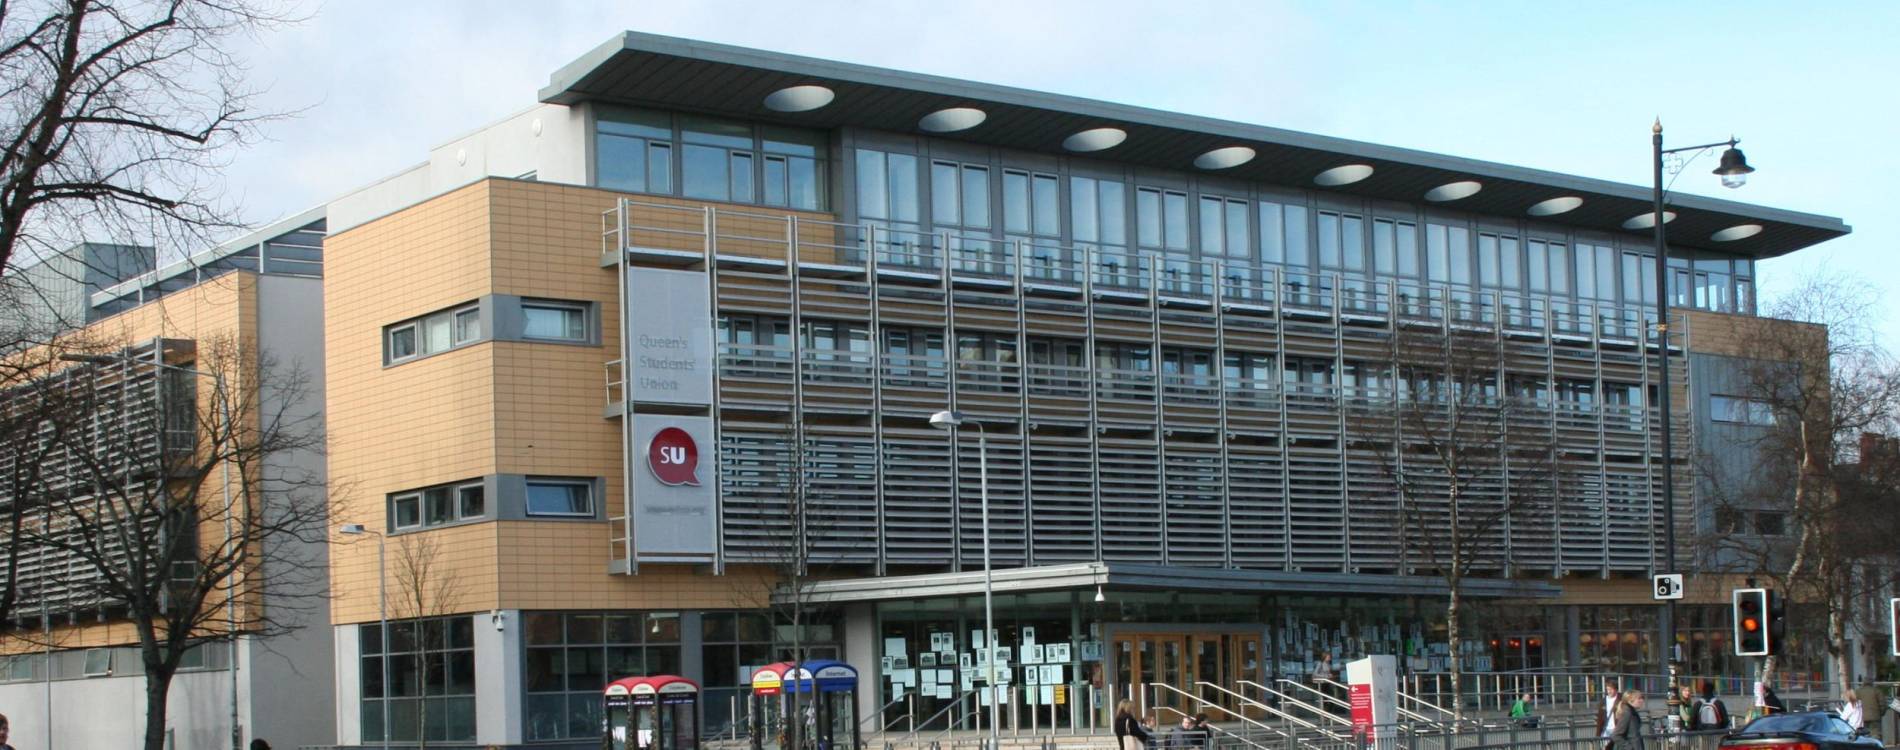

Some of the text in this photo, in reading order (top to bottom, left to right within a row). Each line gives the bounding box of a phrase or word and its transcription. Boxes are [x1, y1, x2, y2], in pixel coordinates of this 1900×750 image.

[640, 334, 688, 349] Queen's
[640, 377, 678, 390] Union
[660, 446, 686, 465] SU
